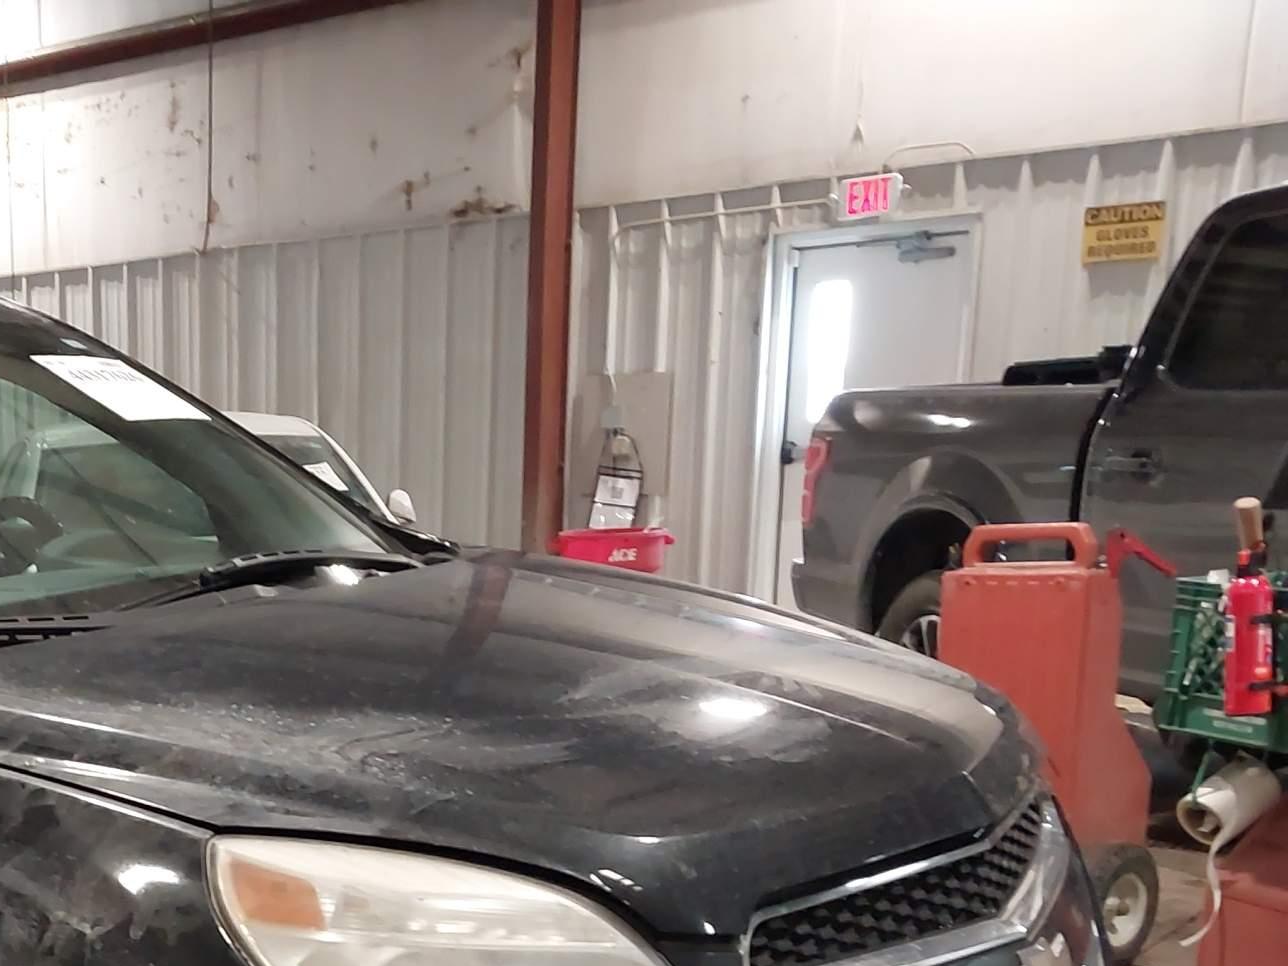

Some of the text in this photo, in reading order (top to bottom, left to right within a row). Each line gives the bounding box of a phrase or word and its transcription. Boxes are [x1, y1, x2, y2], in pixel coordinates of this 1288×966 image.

[847, 176, 893, 216] EXIT
[1085, 202, 1164, 224] CAUTION
[1095, 224, 1150, 242] GLOVES
[1087, 240, 1156, 259] REQUIRED
[607, 547, 638, 562] ACE
